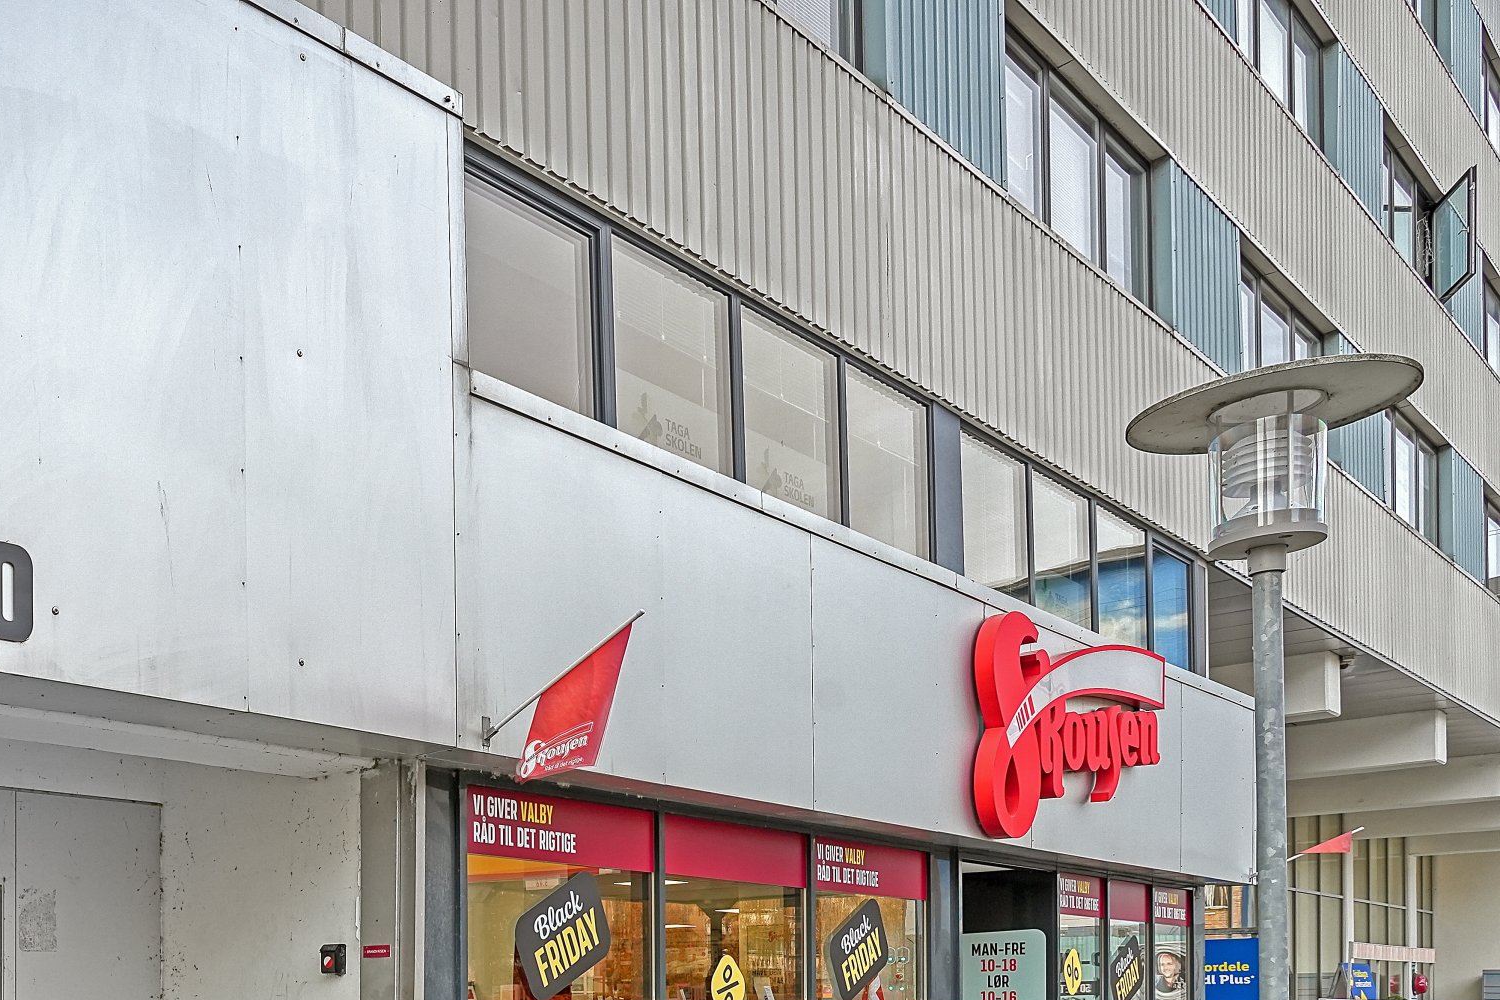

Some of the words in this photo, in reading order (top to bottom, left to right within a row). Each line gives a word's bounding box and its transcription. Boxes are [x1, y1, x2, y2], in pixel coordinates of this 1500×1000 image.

[665, 418, 690, 439] TAGA
[665, 434, 702, 460] SKOLEN
[783, 471, 805, 490] TAGA
[784, 485, 815, 508] SKOLEN
[473, 794, 484, 816] VI
[487, 795, 518, 821] GIVER
[520, 801, 553, 825] VALBY
[473, 816, 496, 844] RÅD
[498, 824, 514, 847] TIL
[517, 826, 536, 849] DET
[539, 829, 577, 854] RIGTIGE
[817, 843, 824, 860] VI
[825, 844, 844, 863] GIVER
[844, 847, 865, 866] VALBY
[817, 859, 831, 882] RÅD
[831, 866, 842, 883] TIL
[842, 867, 855, 885] DET
[856, 869, 879, 888] RIGTIGE
[533, 890, 584, 941] Black
[840, 914, 872, 956] Black
[534, 907, 600, 988] FRIDAY
[971, 942, 1026, 956] MAN-FRE
[841, 927, 882, 992] FRIDAY
[980, 959, 1017, 972] 10-18
[1204, 961, 1250, 972] ordele
[987, 975, 1010, 988] LØR
[1204, 974, 1216, 984] dl
